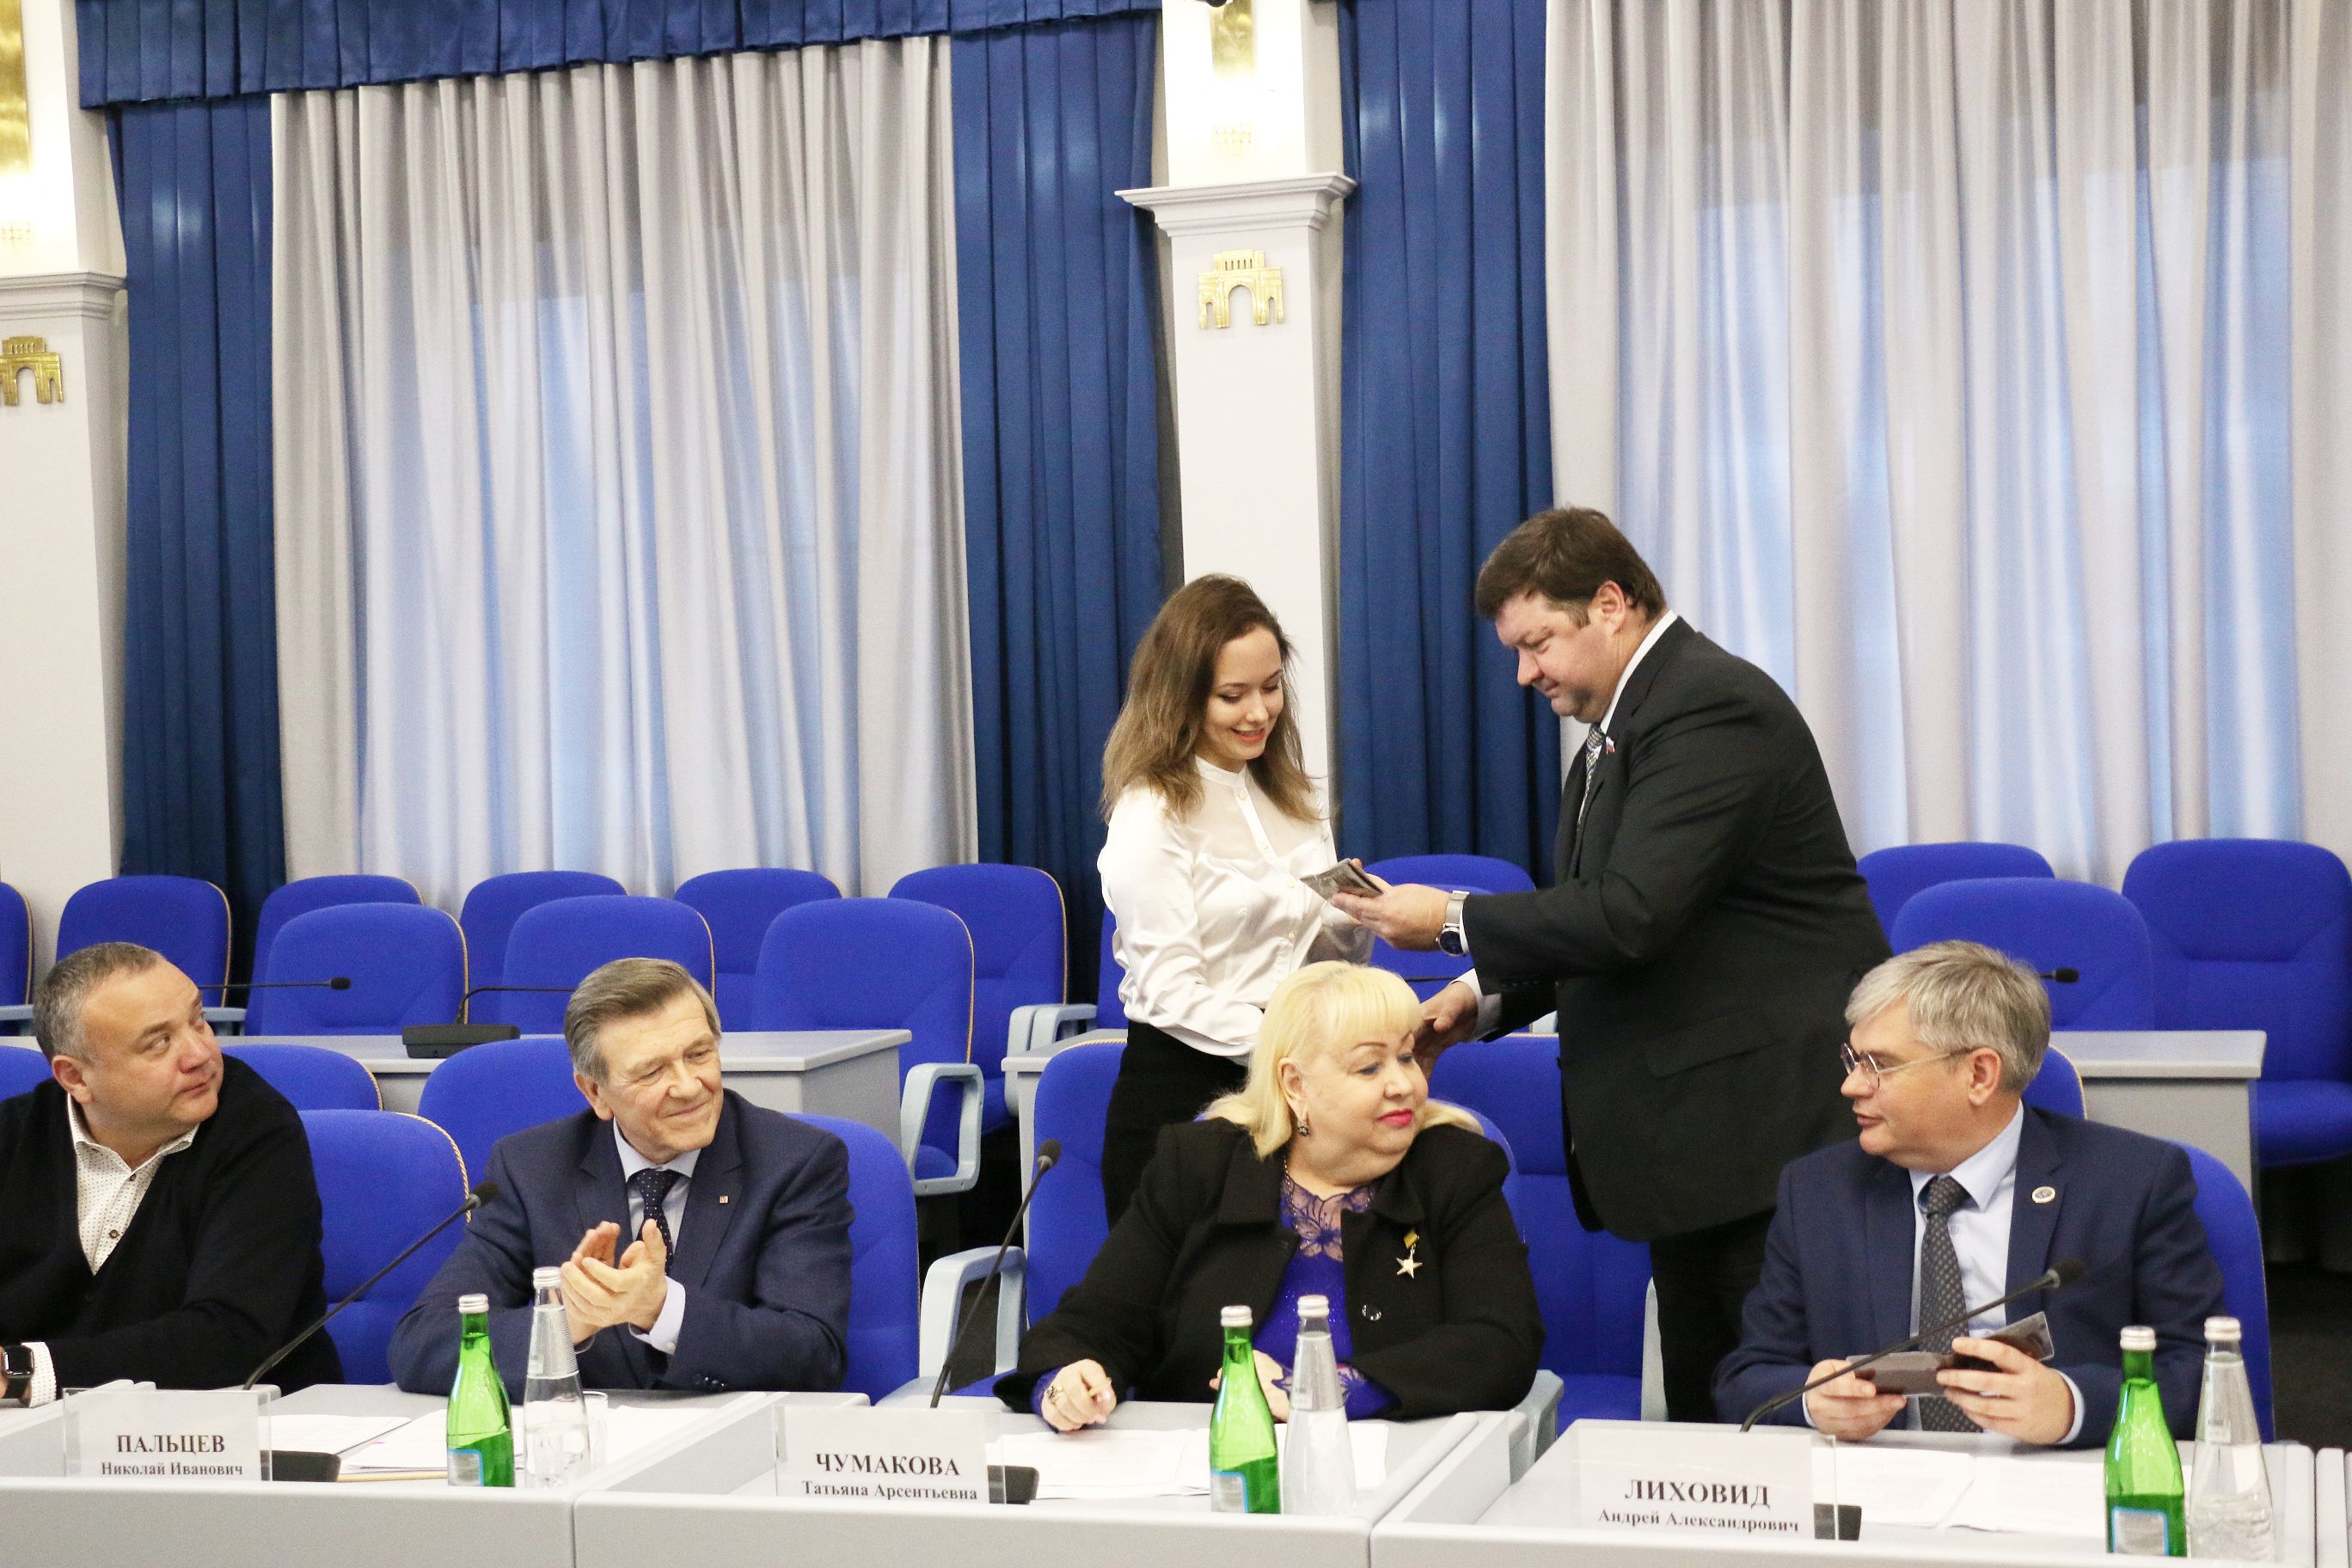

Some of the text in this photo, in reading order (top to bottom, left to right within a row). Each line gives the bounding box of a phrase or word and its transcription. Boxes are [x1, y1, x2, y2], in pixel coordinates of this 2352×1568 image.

[117, 1435, 225, 1455] ПАЛЬЦЕВ
[101, 1461, 243, 1476] Николай Иванович
[816, 1453, 960, 1476] ЧУМАКОВА
[801, 1480, 977, 1500] Татьяна Арсентьевна
[1624, 1479, 1771, 1510] ЛИХОВИД
[1598, 1509, 1799, 1534] Андрей Александрович
